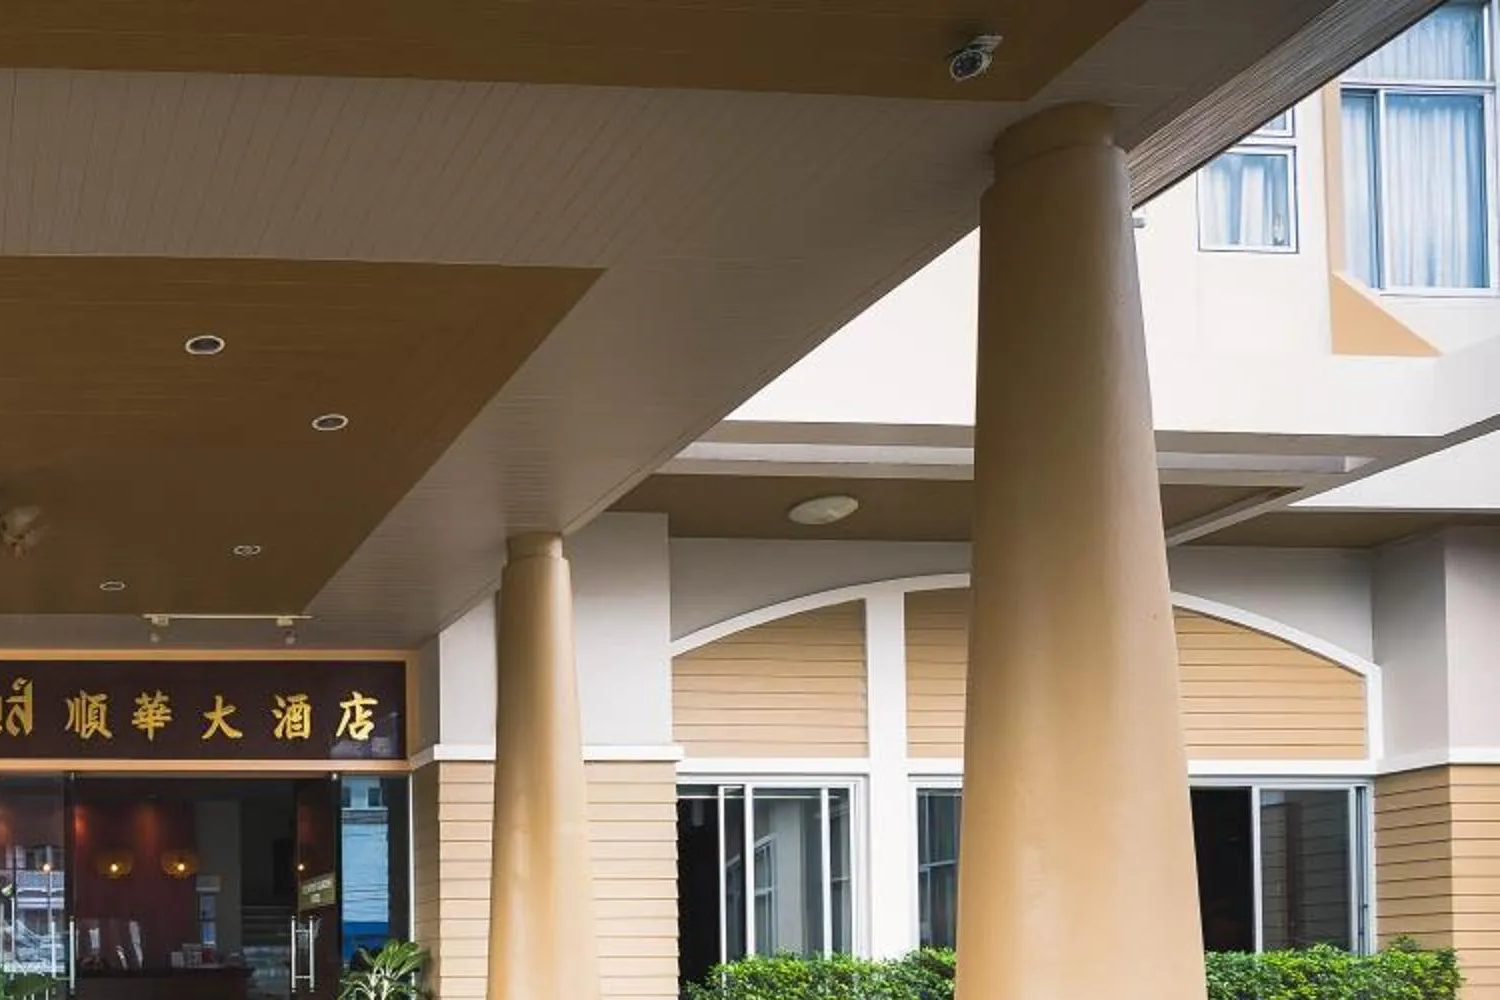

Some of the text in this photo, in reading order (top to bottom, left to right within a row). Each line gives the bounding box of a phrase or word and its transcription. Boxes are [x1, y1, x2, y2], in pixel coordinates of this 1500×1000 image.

[64, 689, 379, 741] 順華大酒店
